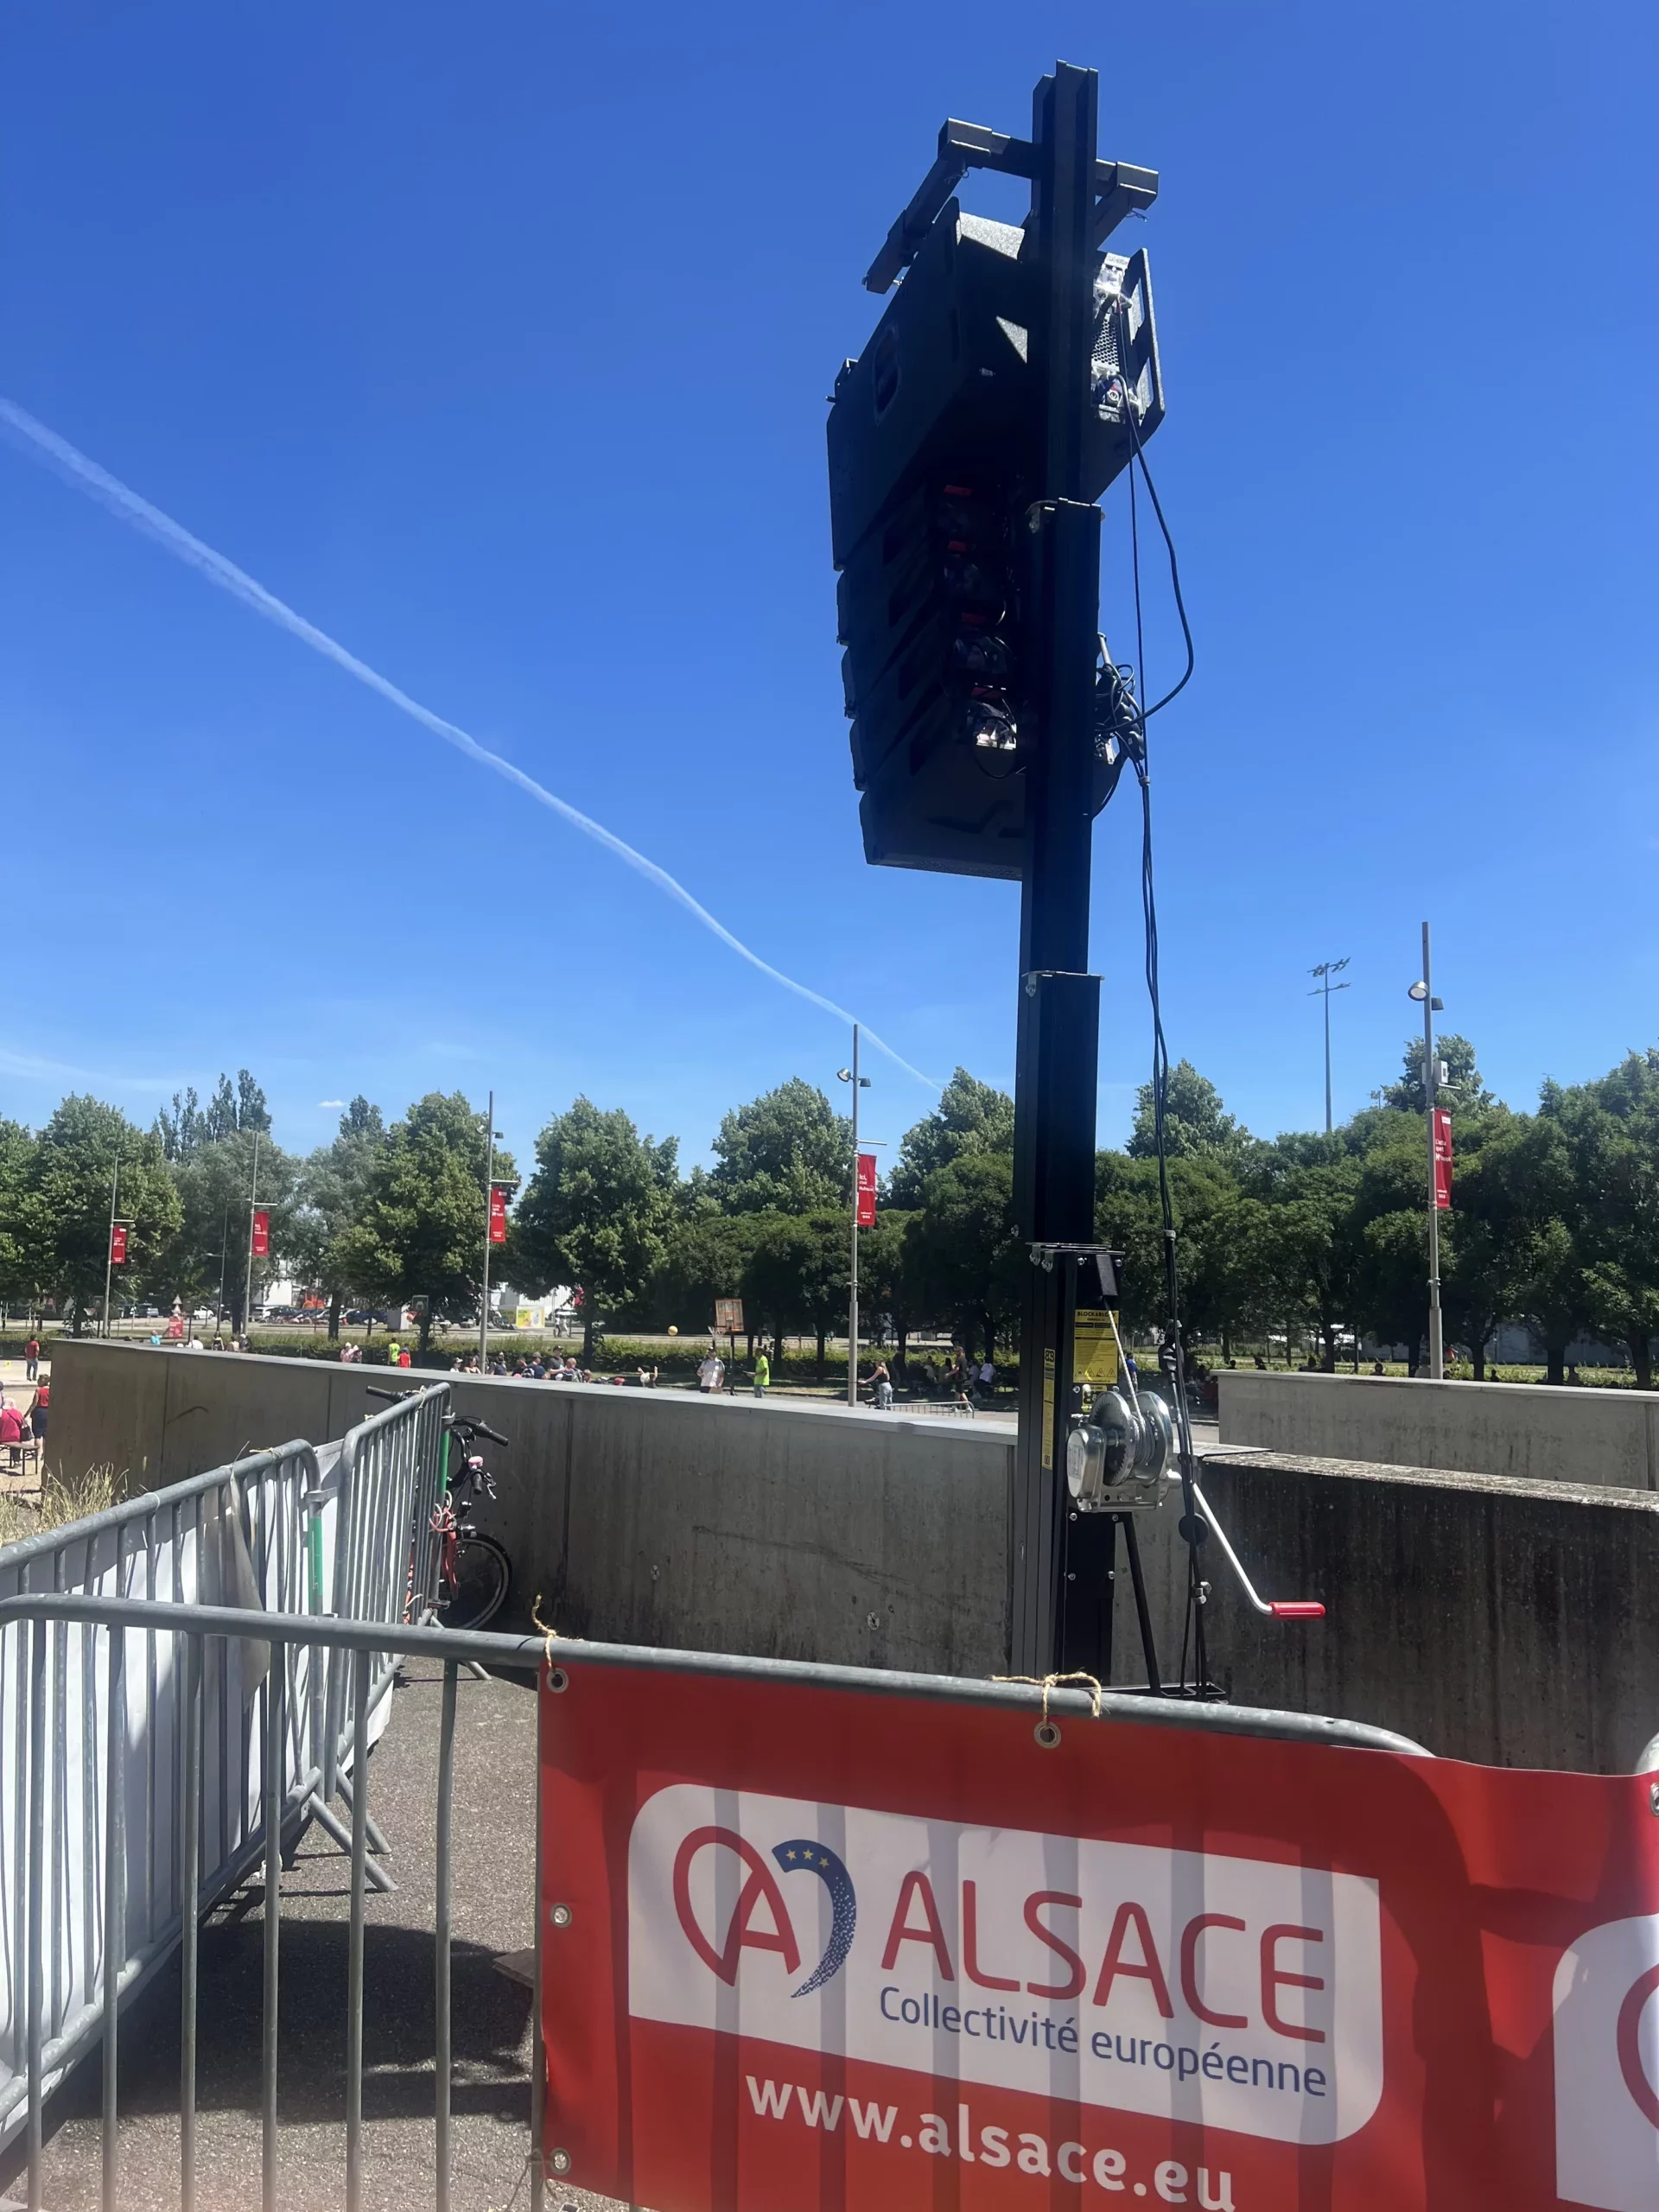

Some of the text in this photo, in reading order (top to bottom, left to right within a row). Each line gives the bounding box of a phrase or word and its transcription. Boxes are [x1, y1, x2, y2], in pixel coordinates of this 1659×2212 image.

[880, 1870, 1326, 2044] ALSACE
[880, 1986, 1327, 2097] Collectivité européenne
[745, 2075, 1236, 2212] www.alsace.eu
